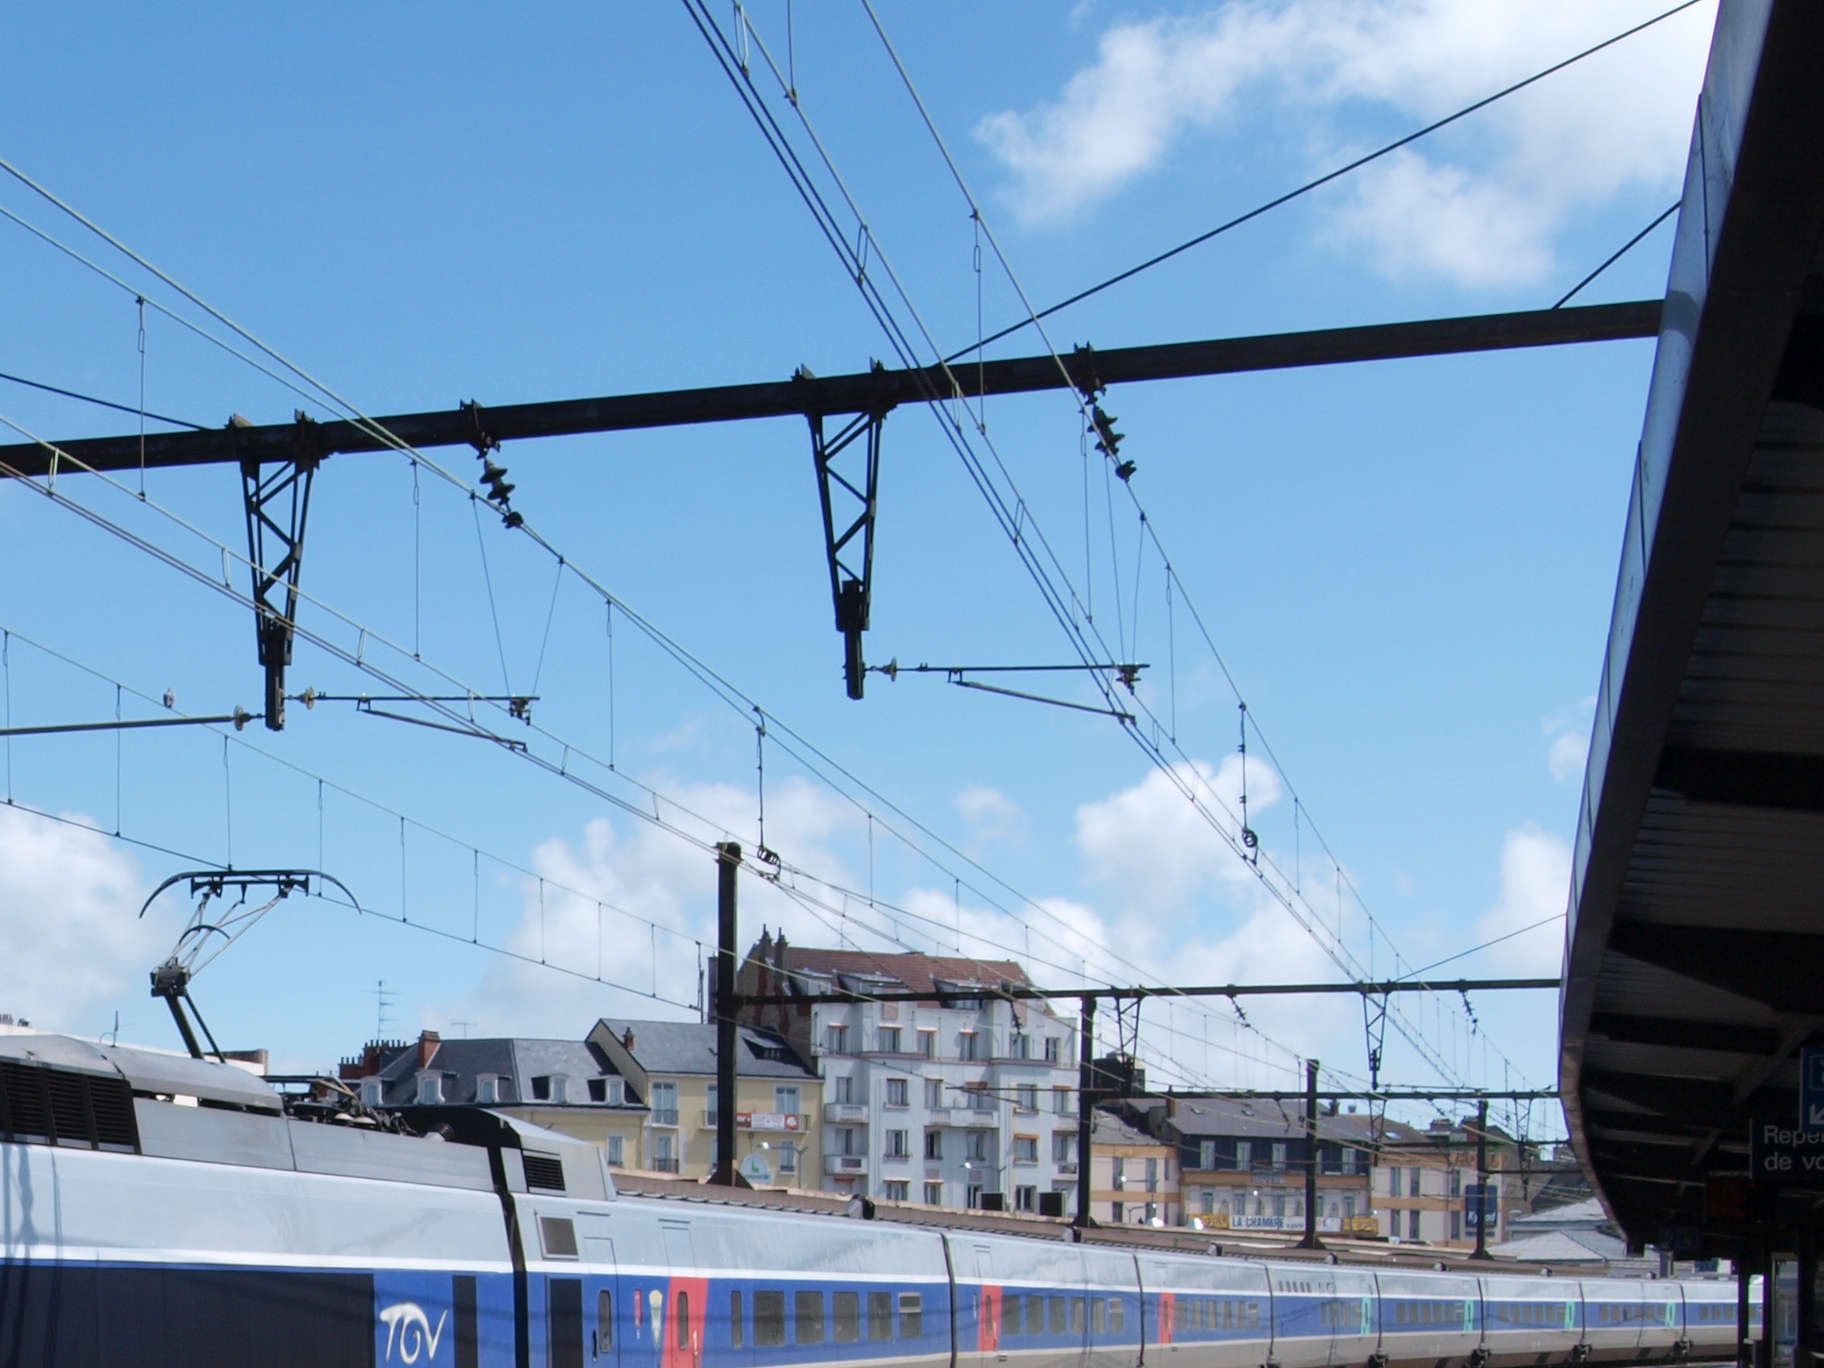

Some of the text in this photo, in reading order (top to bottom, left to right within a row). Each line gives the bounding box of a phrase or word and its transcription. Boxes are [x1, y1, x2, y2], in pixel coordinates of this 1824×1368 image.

[1764, 1151, 1792, 1171] de
[1232, 1216, 1243, 1228] LA
[1246, 1216, 1284, 1230] CHAMBRE
[379, 1301, 449, 1366] TGV
